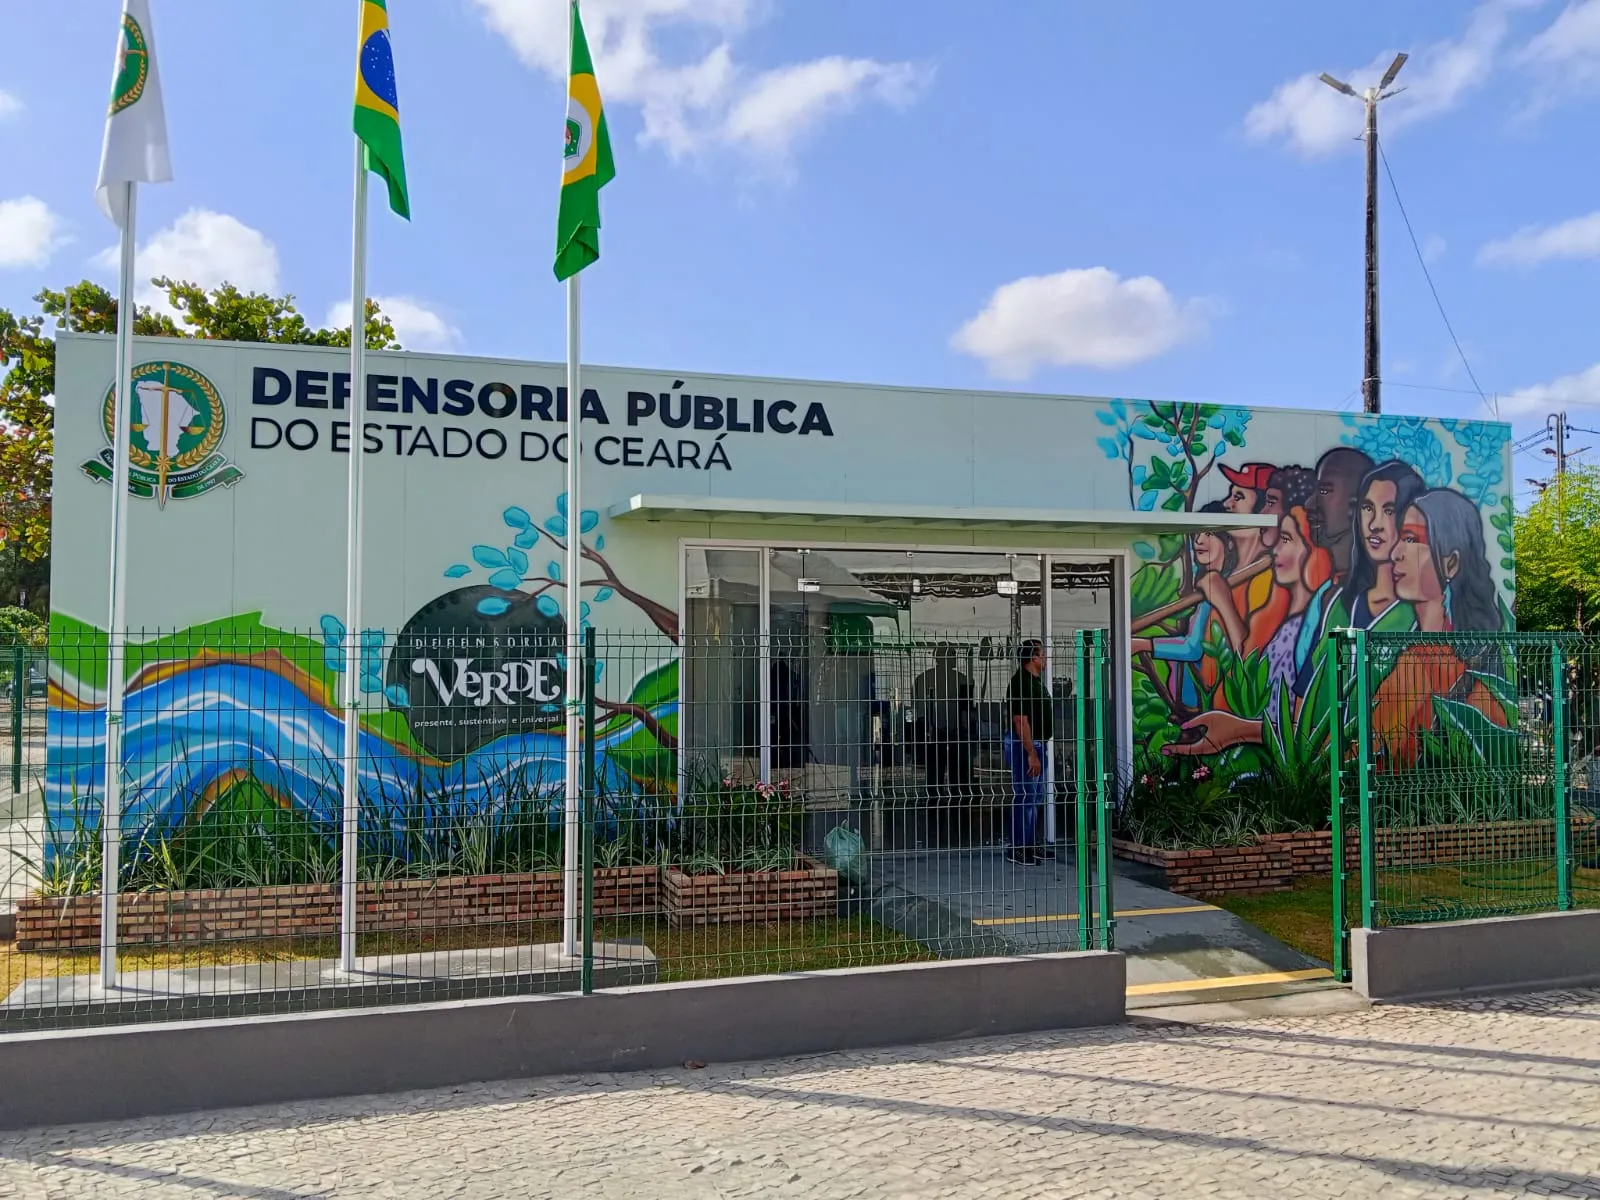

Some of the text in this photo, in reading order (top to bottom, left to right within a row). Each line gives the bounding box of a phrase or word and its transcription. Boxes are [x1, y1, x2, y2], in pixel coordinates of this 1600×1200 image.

[252, 366, 834, 436] DEFENSORIA PÚBLICA
[251, 417, 732, 471] DO ESTADO DO CEARÁ
[415, 636, 558, 650] DEFENSORIA
